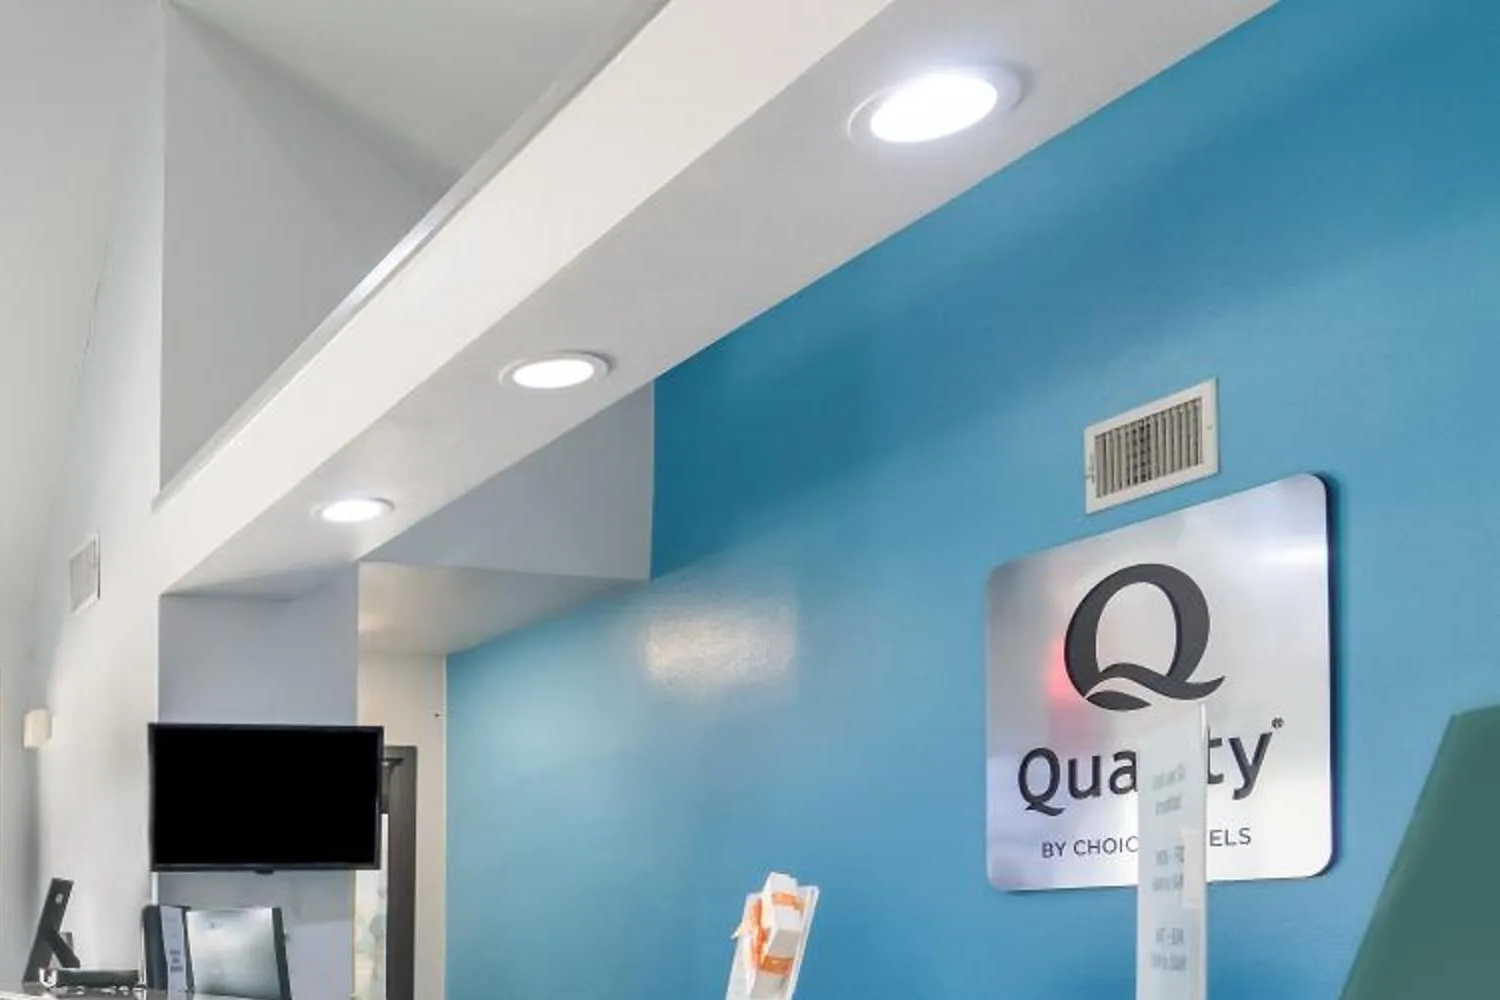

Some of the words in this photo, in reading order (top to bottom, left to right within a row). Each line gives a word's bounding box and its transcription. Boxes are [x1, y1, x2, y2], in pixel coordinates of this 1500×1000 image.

[1063, 563, 1225, 711] Q
[1017, 725, 1274, 817] Quaty
[1041, 840, 1067, 859] BY
[1073, 835, 1139, 857] CHOIC
